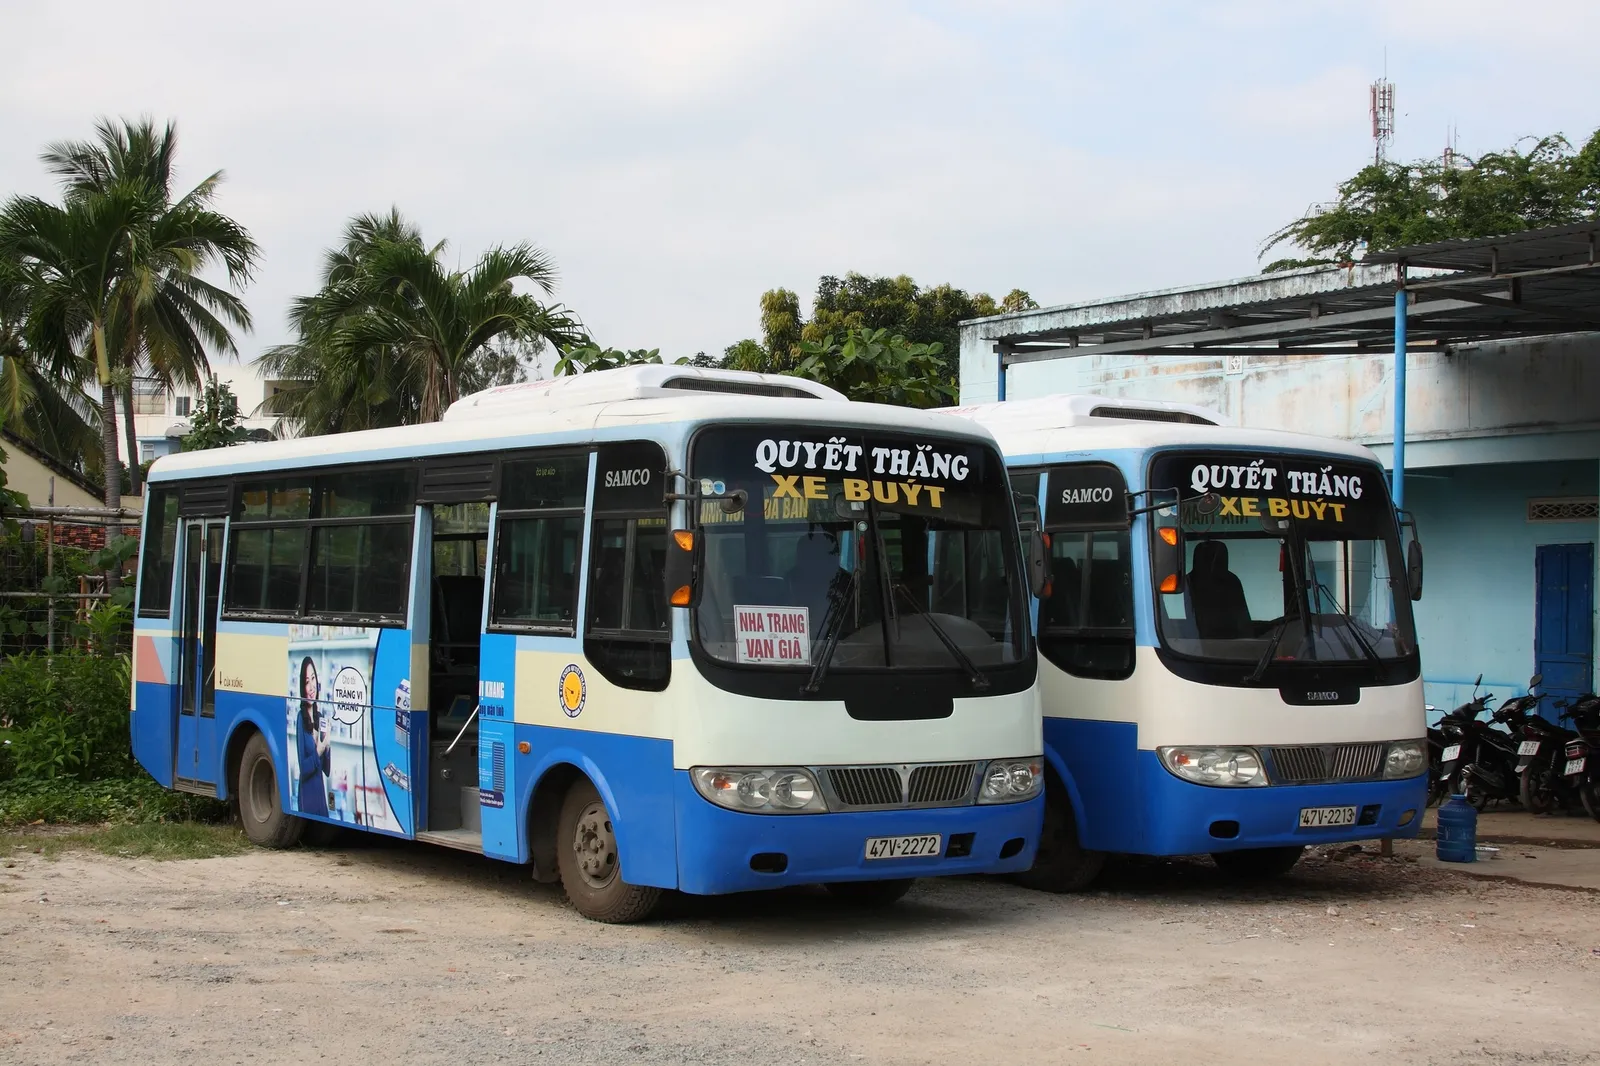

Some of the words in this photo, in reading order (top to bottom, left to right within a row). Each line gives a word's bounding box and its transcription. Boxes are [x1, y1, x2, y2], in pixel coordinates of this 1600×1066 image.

[754, 436, 863, 473] QUYẾT
[871, 443, 970, 481] THẮNG
[605, 468, 651, 488] SAMCO
[1190, 459, 1278, 493] QUYẾT
[1287, 465, 1363, 500] THẮNG
[770, 474, 829, 499] XE
[843, 478, 945, 508] BUÝT
[1062, 487, 1113, 504] SAMCO
[1219, 496, 1262, 517] XE
[1268, 497, 1346, 522] BUÝT
[739, 612, 765, 632] NHA
[766, 612, 805, 634] TRANG
[778, 636, 802, 660] GIÃ
[485, 681, 505, 699] KHANG
[1306, 691, 1339, 701] SAMCO
[337, 700, 360, 712] KHANG
[1302, 808, 1354, 825] 47V-2213
[869, 836, 937, 857] 47V-2272
